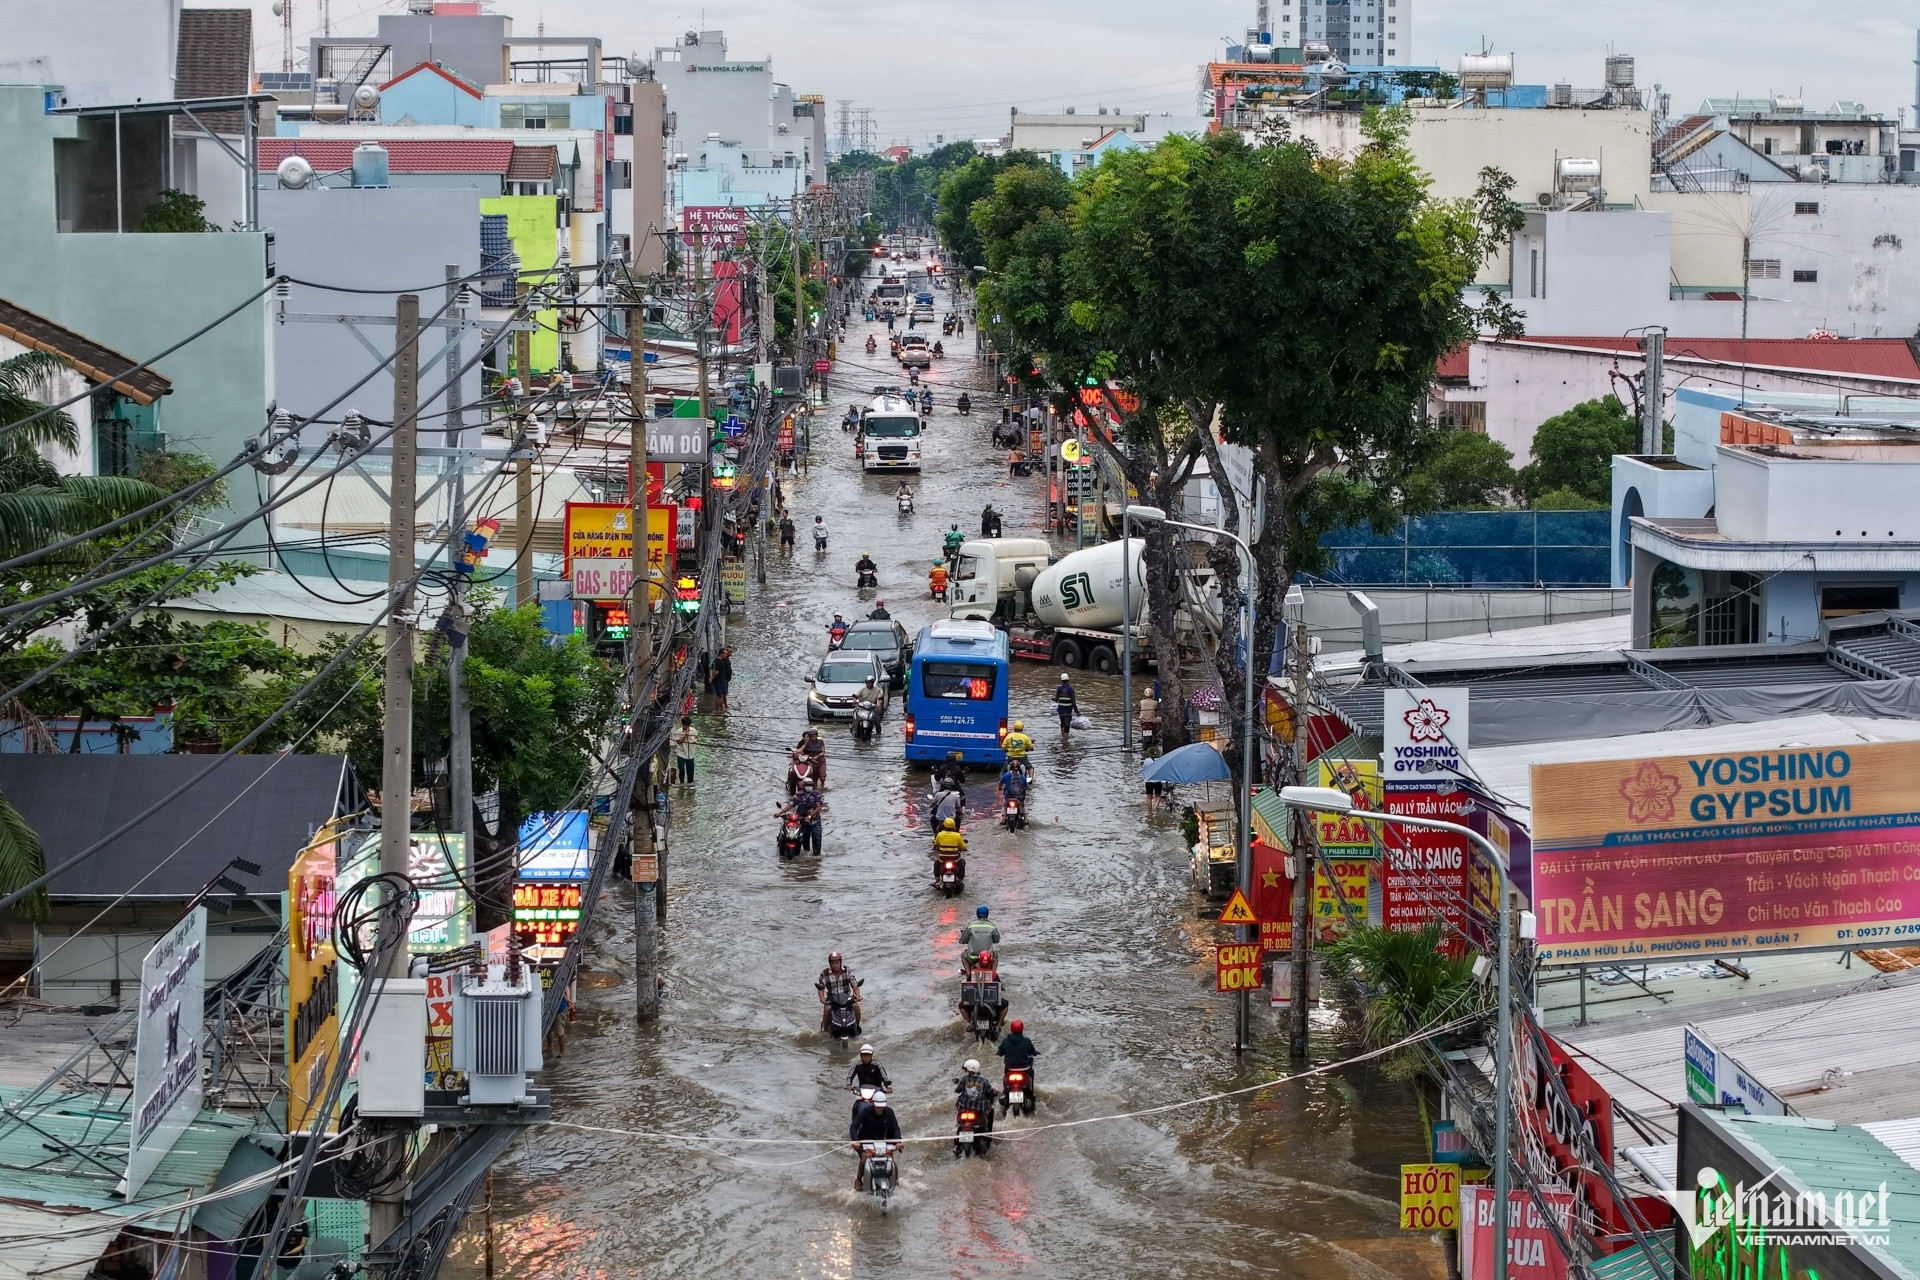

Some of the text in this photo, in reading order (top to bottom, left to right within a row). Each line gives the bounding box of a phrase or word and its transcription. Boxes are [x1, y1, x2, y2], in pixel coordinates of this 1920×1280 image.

[706, 207, 739, 220] THỐNG
[680, 426, 702, 455] ĐỒ
[573, 529, 585, 540] CỬA
[587, 530, 603, 540] HÀNG
[605, 531, 619, 542] ĐIỆN
[621, 533, 632, 541] THO
[576, 569, 600, 595] GAS
[609, 562, 633, 595] BẾP
[1394, 746, 1459, 758] YOSHINO
[1394, 760, 1459, 771] GYPUM
[1689, 750, 1851, 787] YOSHINO
[1406, 799, 1415, 815] LÝ
[1416, 796, 1437, 814] TRẦN
[1690, 785, 1851, 822] GYPSUM
[1321, 815, 1371, 843] TẤM
[1646, 831, 1690, 842] THẠCH
[1693, 829, 1719, 839] CAO
[1767, 825, 1794, 833] 80%
[1797, 821, 1818, 831] THỊ
[1859, 814, 1894, 827] NHẬT
[1389, 836, 1463, 870] TRẦN SANG
[1540, 851, 1722, 878] ĐẠI LÝ TRẦN VÁCH THẠCH CAO
[1746, 850, 1790, 866] Chuyên
[1793, 848, 1824, 864] Cung
[1855, 843, 1871, 857] Và
[1873, 842, 1890, 856] Thi
[1317, 880, 1366, 899] TẤM
[1746, 871, 1774, 893] Trần
[1784, 872, 1819, 890] Vách
[1822, 869, 1857, 891] Ngăn
[1860, 866, 1899, 888] Thạch
[1903, 865, 1920, 882] Ca
[514, 886, 580, 907] BÃI XE 70
[1540, 875, 1624, 936] TRẦN
[1634, 887, 1724, 930] SANG
[1747, 896, 1903, 922] Chỉ Hoa Văn Thạch Cao
[1401, 907, 1413, 916] HOA
[1262, 922, 1292, 936] 68 PHẠM
[1837, 929, 1853, 939] ĐT:
[1857, 926, 1891, 938] 09377
[1219, 945, 1260, 966] CHAY
[1275, 938, 1292, 949] 0392
[1539, 950, 1553, 960] 68
[1556, 946, 1591, 960] PHẠM
[1594, 943, 1619, 956] HỮU
[1650, 938, 1701, 952] PHƯỜNG
[1705, 935, 1728, 948] PHÚ
[1731, 936, 1752, 947] MỸ,
[1755, 933, 1790, 946] QUẬN
[1793, 933, 1800, 942] 7
[1220, 967, 1259, 990] 10K
[171, 1037, 197, 1093] Jewels
[1686, 1031, 1714, 1076] Salonpas
[1404, 1166, 1456, 1195] HỚT
[1405, 1200, 1454, 1229] TÓC
[1478, 1195, 1521, 1228] BÁH
